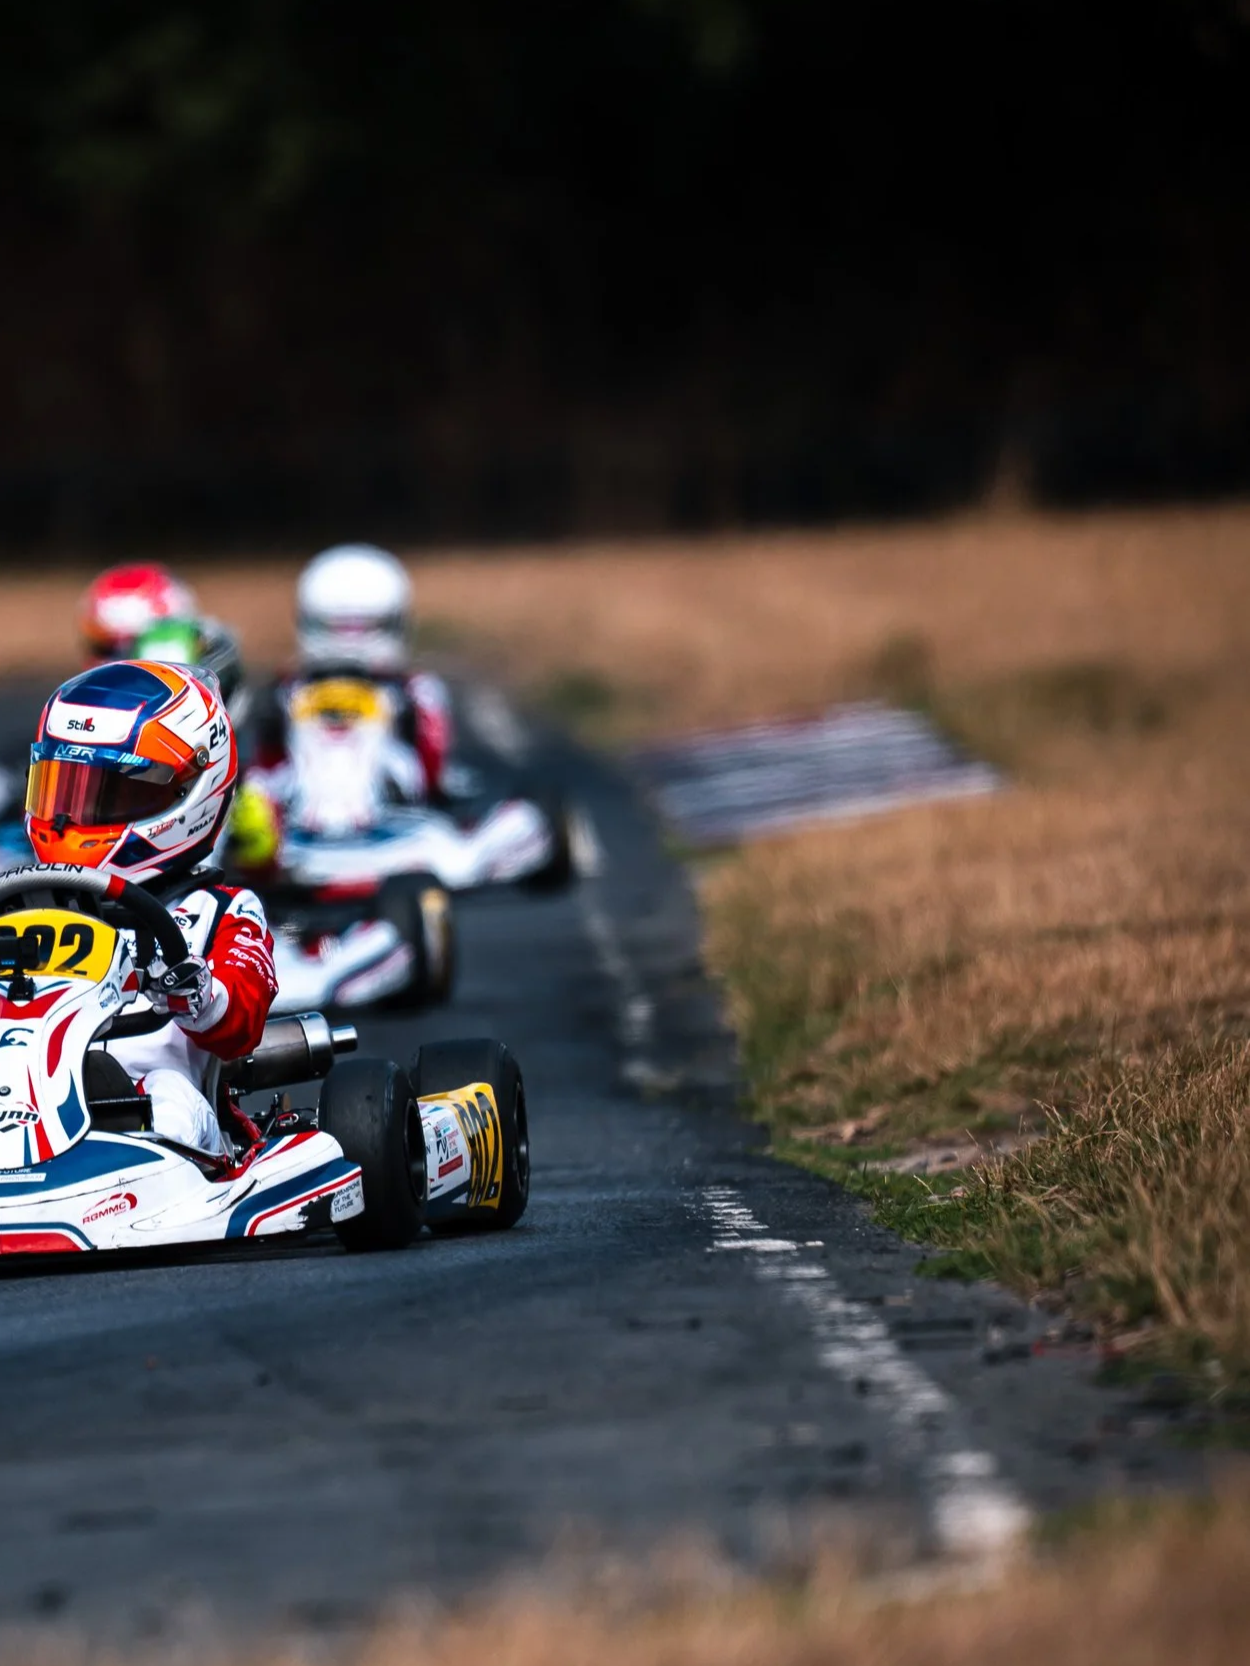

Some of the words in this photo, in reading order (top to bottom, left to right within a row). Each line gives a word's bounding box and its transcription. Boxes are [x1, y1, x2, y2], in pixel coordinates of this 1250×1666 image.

[67, 717, 95, 732] Stilo
[209, 715, 226, 750] 24
[82, 1201, 126, 1225] RGMMC
[334, 1199, 354, 1214] FUTURE
